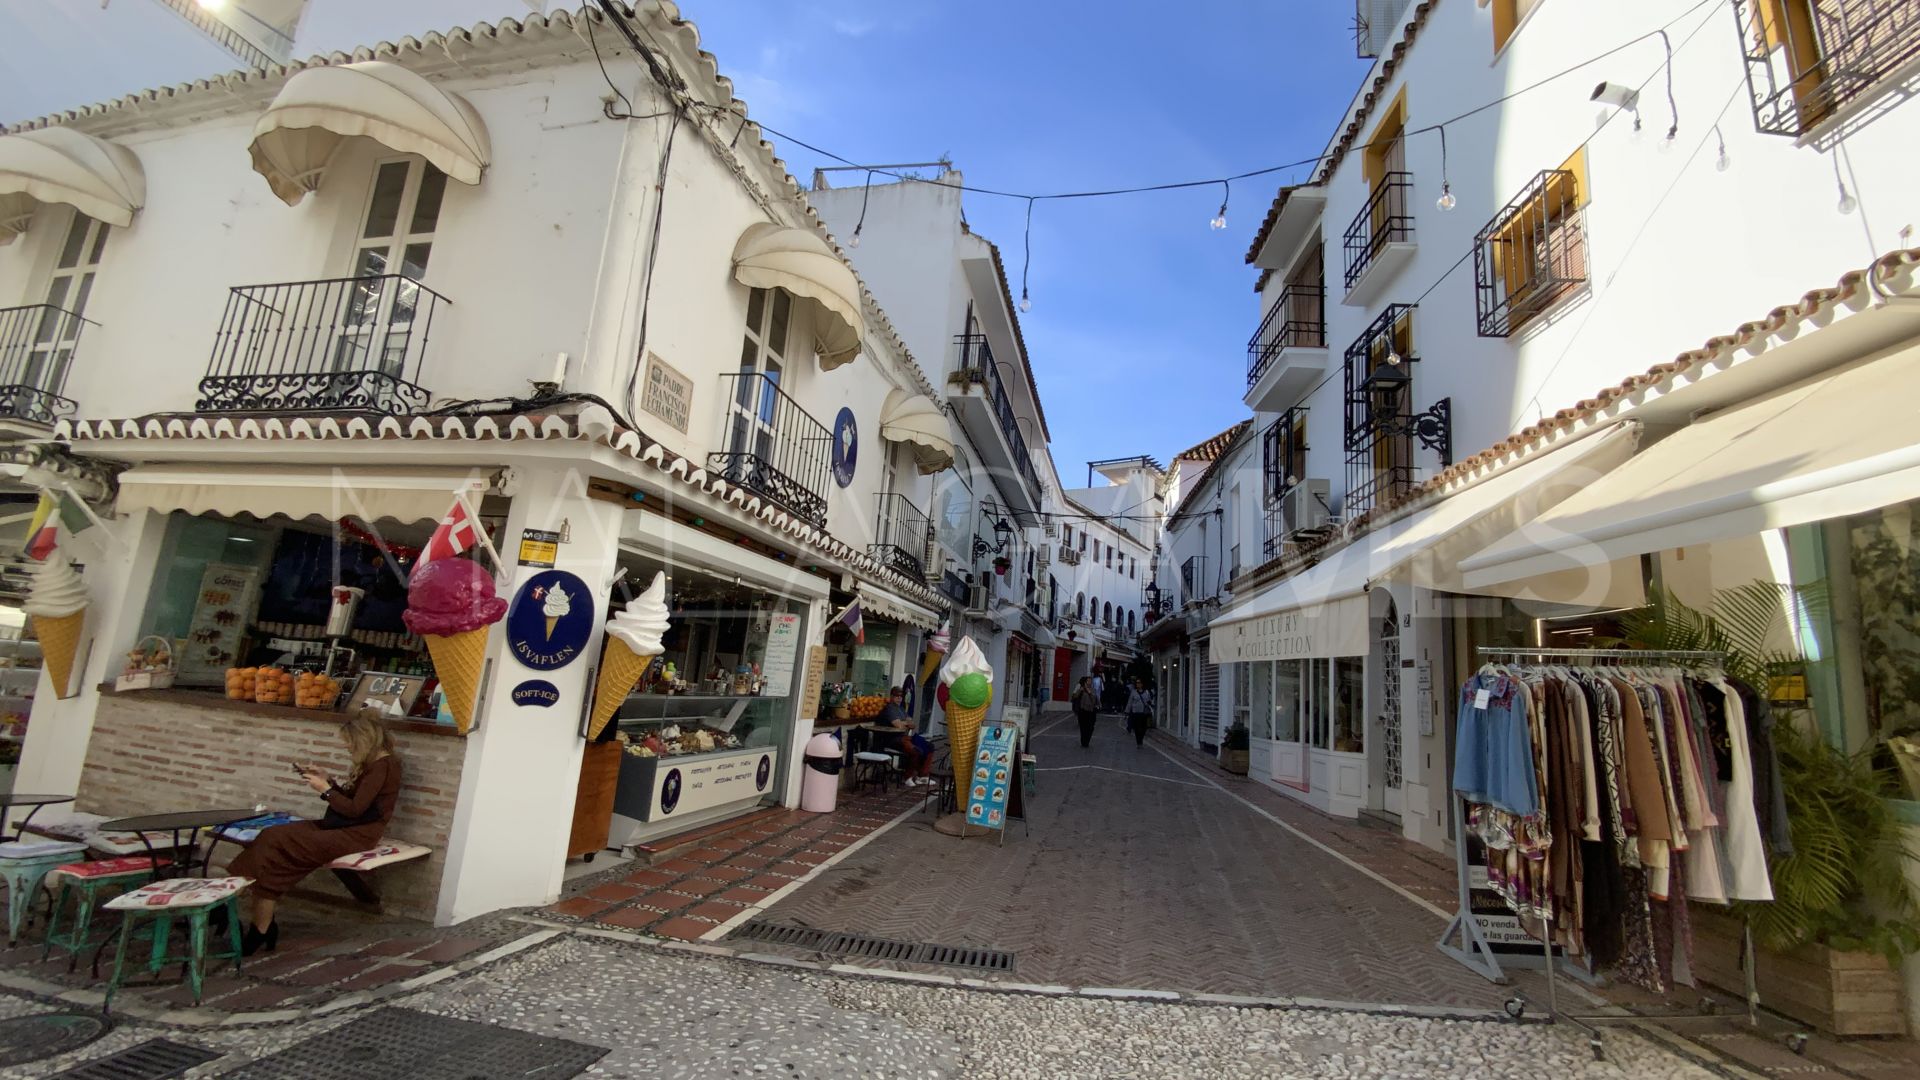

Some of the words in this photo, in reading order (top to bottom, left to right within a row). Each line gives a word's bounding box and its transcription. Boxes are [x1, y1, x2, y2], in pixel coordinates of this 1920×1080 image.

[664, 375, 684, 397] PADRE
[649, 382, 687, 414] FRANCISCO
[646, 396, 686, 428] ECHAMENDI
[1256, 614, 1300, 637] LUXURY
[516, 640, 575, 665] ISVAFLEN
[1245, 635, 1313, 658] COLLECTION
[515, 689, 558, 701] SOFT-ICE
[1491, 919, 1516, 929] venda
